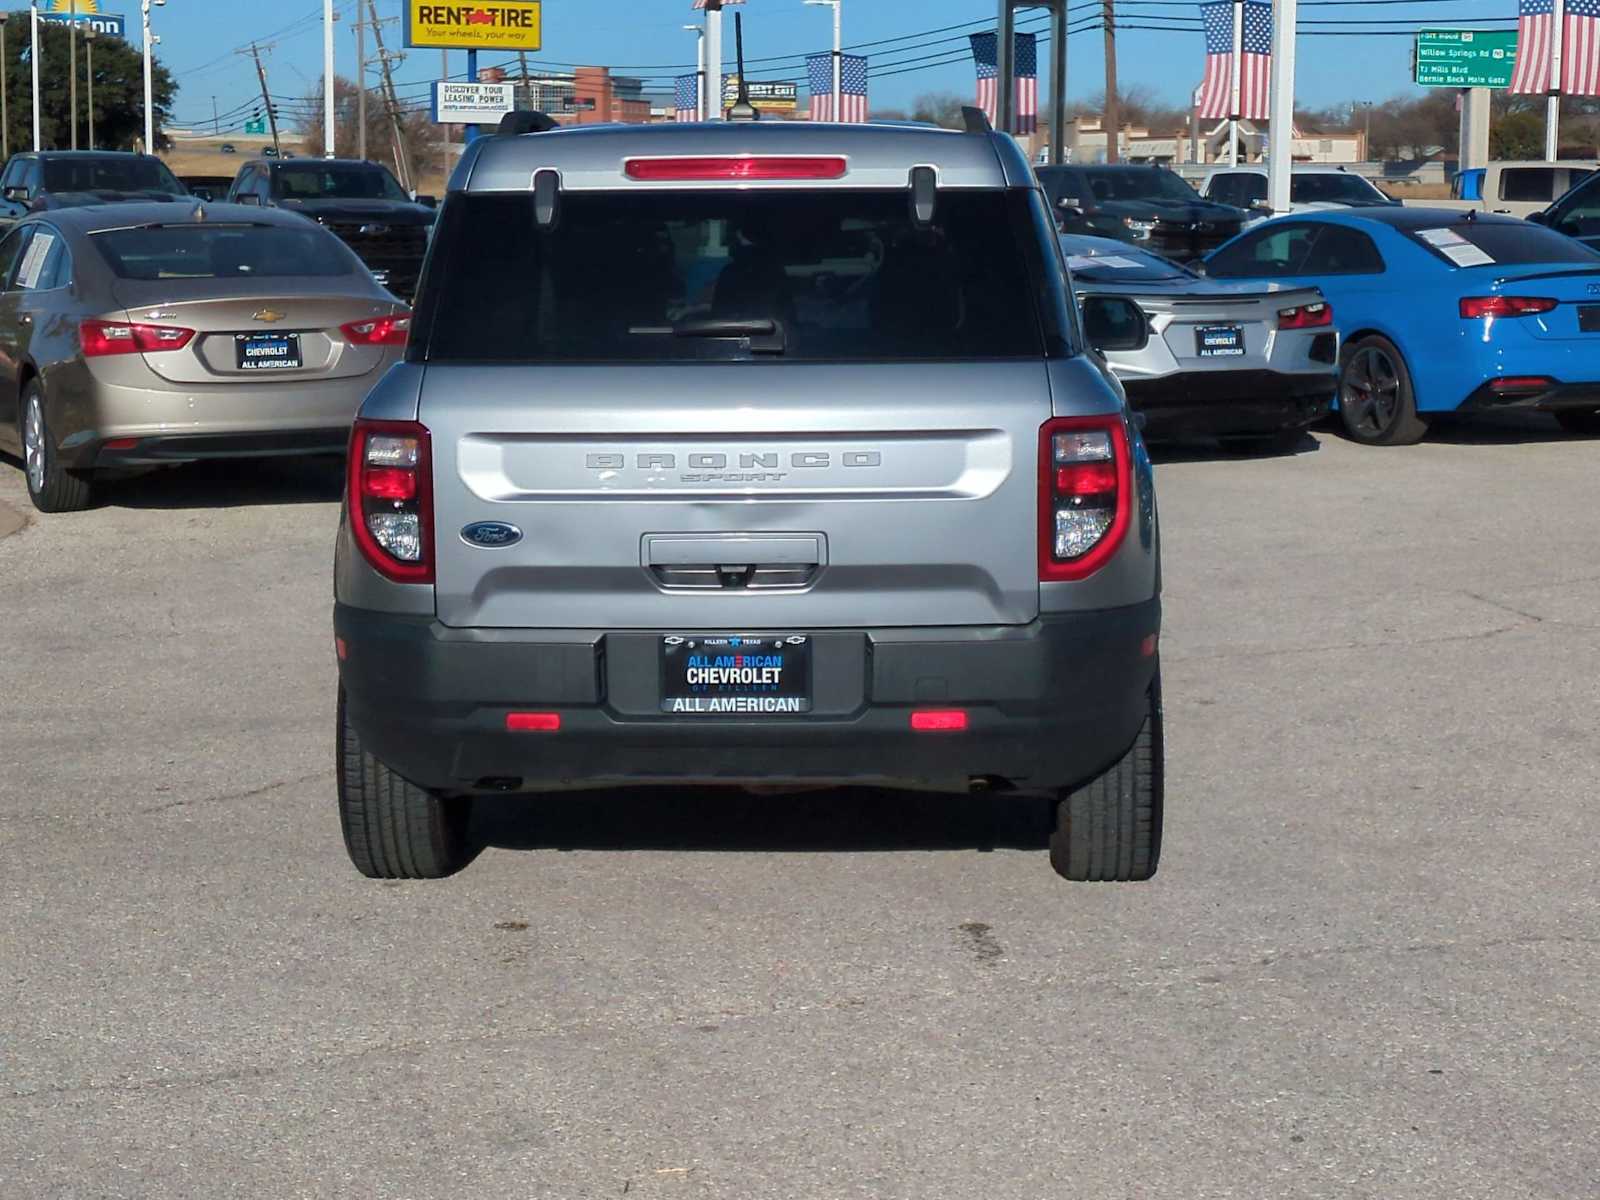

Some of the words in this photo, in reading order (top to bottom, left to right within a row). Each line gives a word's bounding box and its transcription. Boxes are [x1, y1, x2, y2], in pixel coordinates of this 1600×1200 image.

[419, 6, 474, 25] RENT
[487, 8, 533, 27] TIRE
[426, 28, 446, 37] Your
[485, 31, 505, 40] your
[1420, 49, 1446, 57] Willow
[1448, 49, 1477, 58] Springs
[444, 85, 480, 94] DISCOVER
[484, 86, 503, 94] YOUR
[444, 94, 475, 103] LEASING
[479, 95, 504, 103] POWER
[246, 347, 288, 356] CHEVROLET
[258, 360, 298, 369] AMERICAN
[586, 451, 882, 469] BRONCO
[680, 472, 788, 482] SPORT
[688, 655, 711, 667] ALL
[714, 655, 783, 667] AMERICAN
[686, 667, 782, 684] CHEVROLET
[672, 698, 705, 712] ALL
[709, 698, 800, 712] AMERICAN
